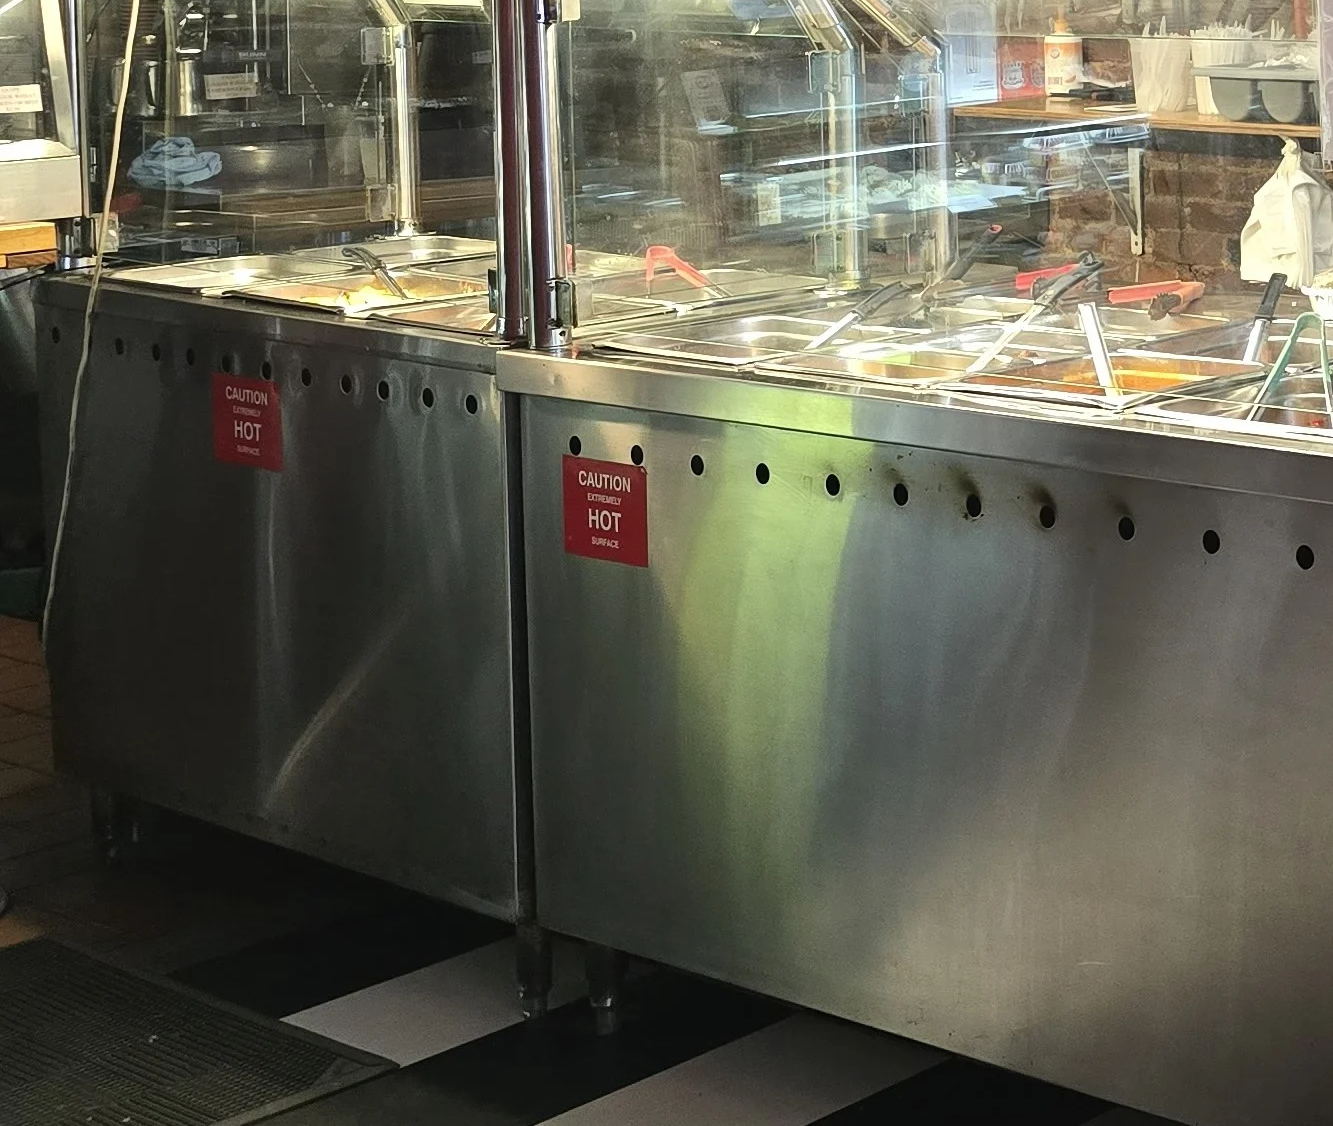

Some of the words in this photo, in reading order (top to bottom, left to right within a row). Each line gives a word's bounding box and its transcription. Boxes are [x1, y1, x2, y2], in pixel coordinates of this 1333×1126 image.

[225, 385, 269, 406] CAUTION
[233, 420, 262, 442] HOT
[578, 470, 631, 493] CAUTION
[588, 508, 622, 533] HOT
[591, 536, 620, 549] SURFACE
